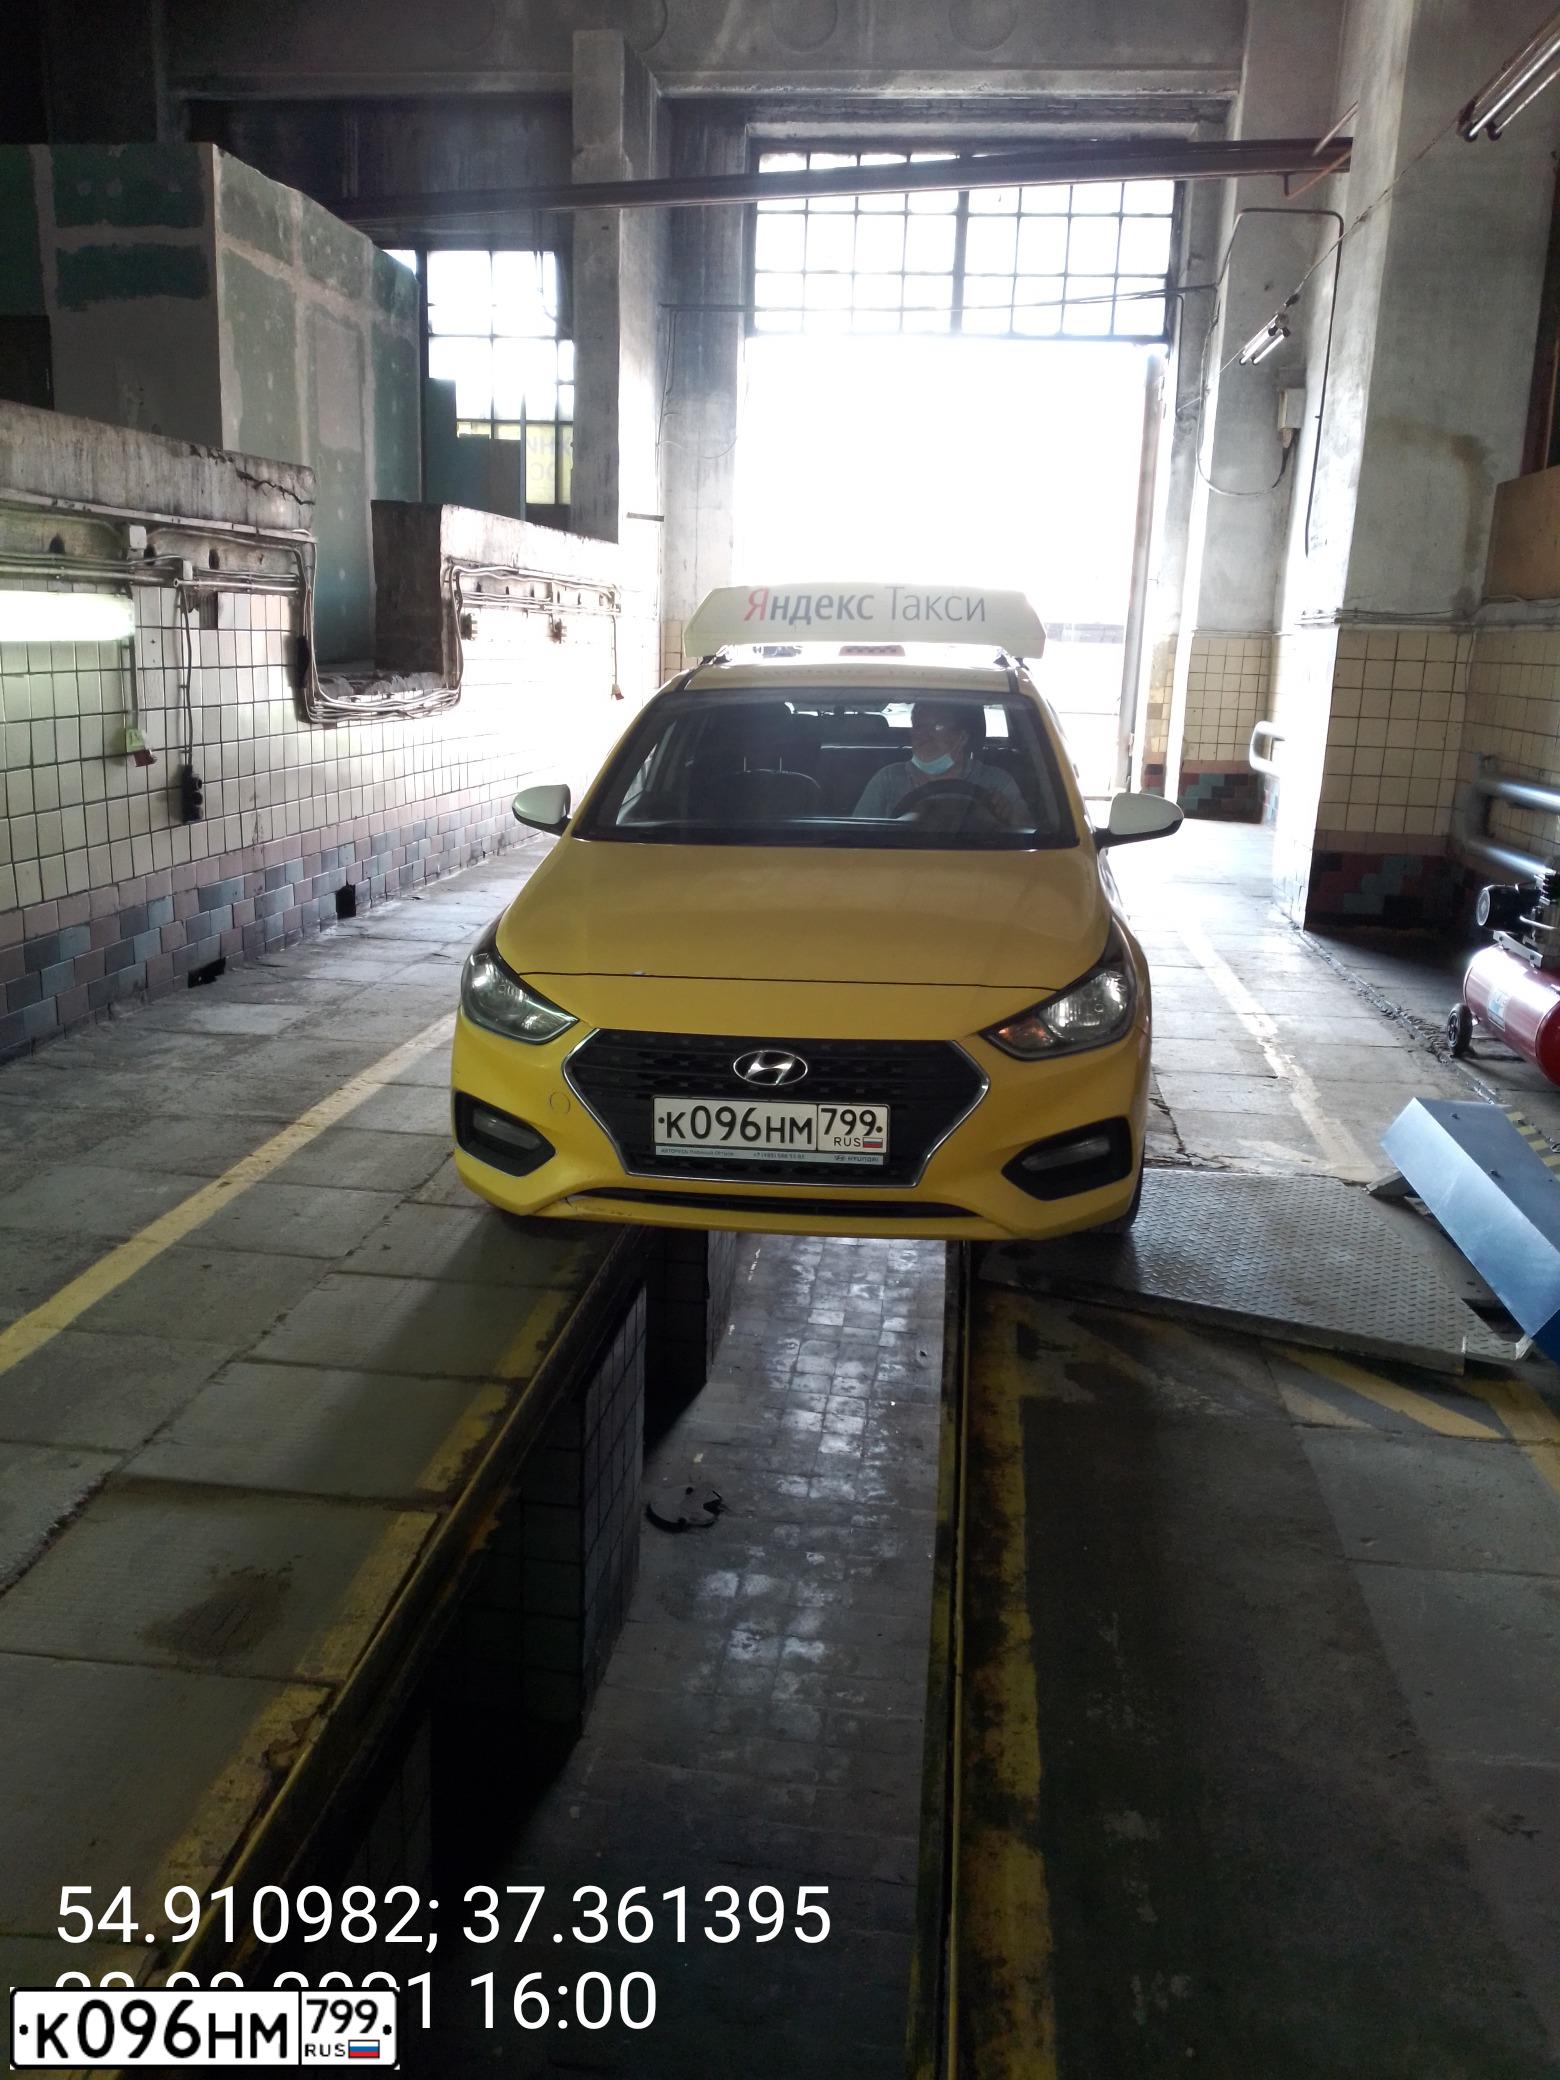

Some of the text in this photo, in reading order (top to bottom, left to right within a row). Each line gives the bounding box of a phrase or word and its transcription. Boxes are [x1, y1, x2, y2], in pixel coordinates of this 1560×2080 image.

[743, 586, 985, 625] Яндекс Такси
[666, 1105, 877, 1144] К096НМ 799
[833, 1137, 861, 1147] RUS
